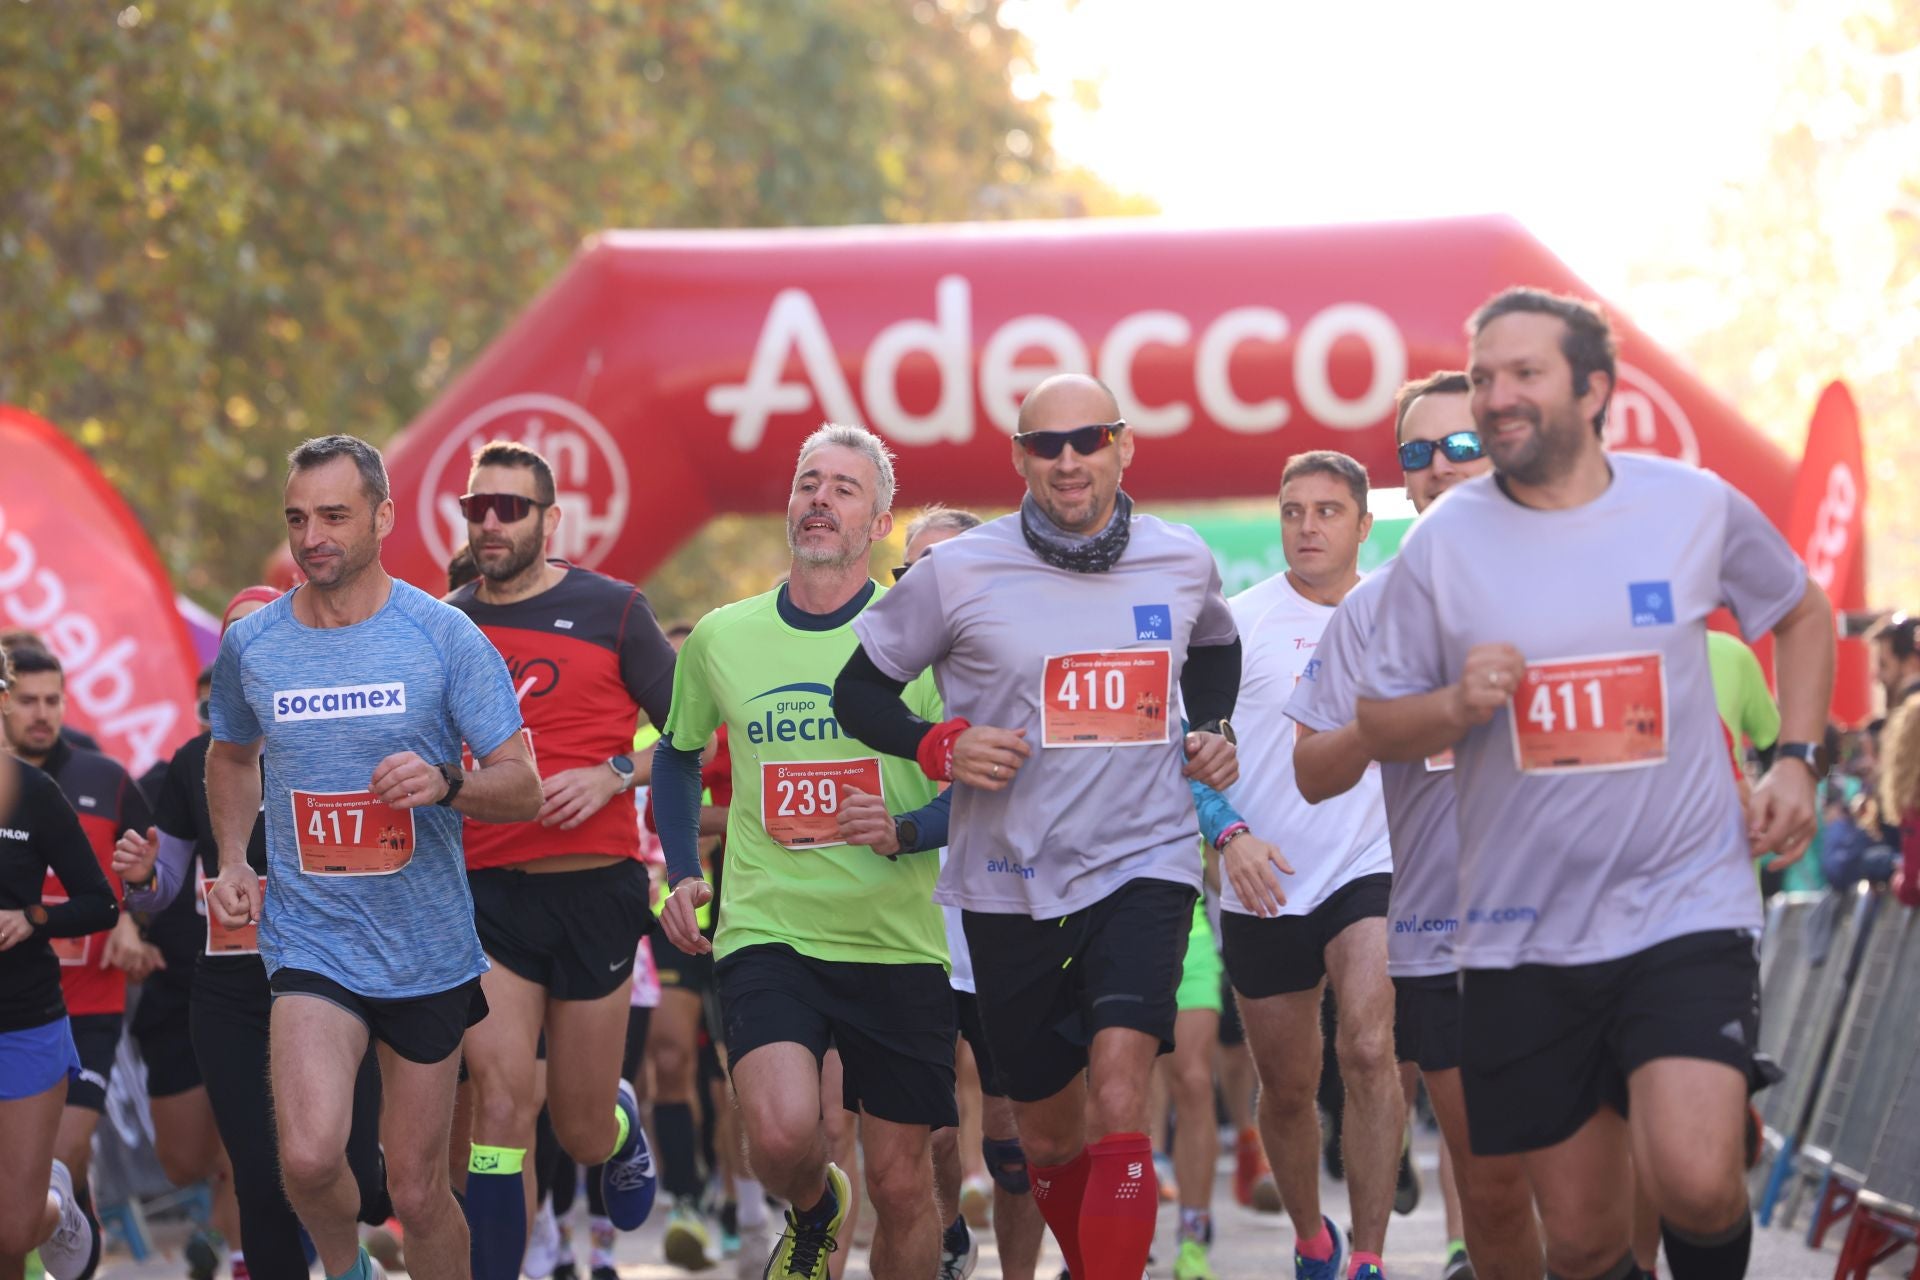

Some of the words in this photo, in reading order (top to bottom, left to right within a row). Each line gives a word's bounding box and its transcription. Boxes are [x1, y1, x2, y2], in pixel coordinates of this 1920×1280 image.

[705, 274, 1408, 453] Adecco
[1139, 630, 1158, 640] AVL
[278, 689, 402, 715] socamex
[1057, 669, 1125, 710] 410
[776, 701, 815, 714] grupo
[1528, 679, 1604, 732] 411
[843, 767, 864, 775] Adecco
[343, 800, 371, 808] empresas
[777, 778, 837, 816] 239
[308, 809, 364, 844] 417
[1395, 914, 1458, 933] avl.com
